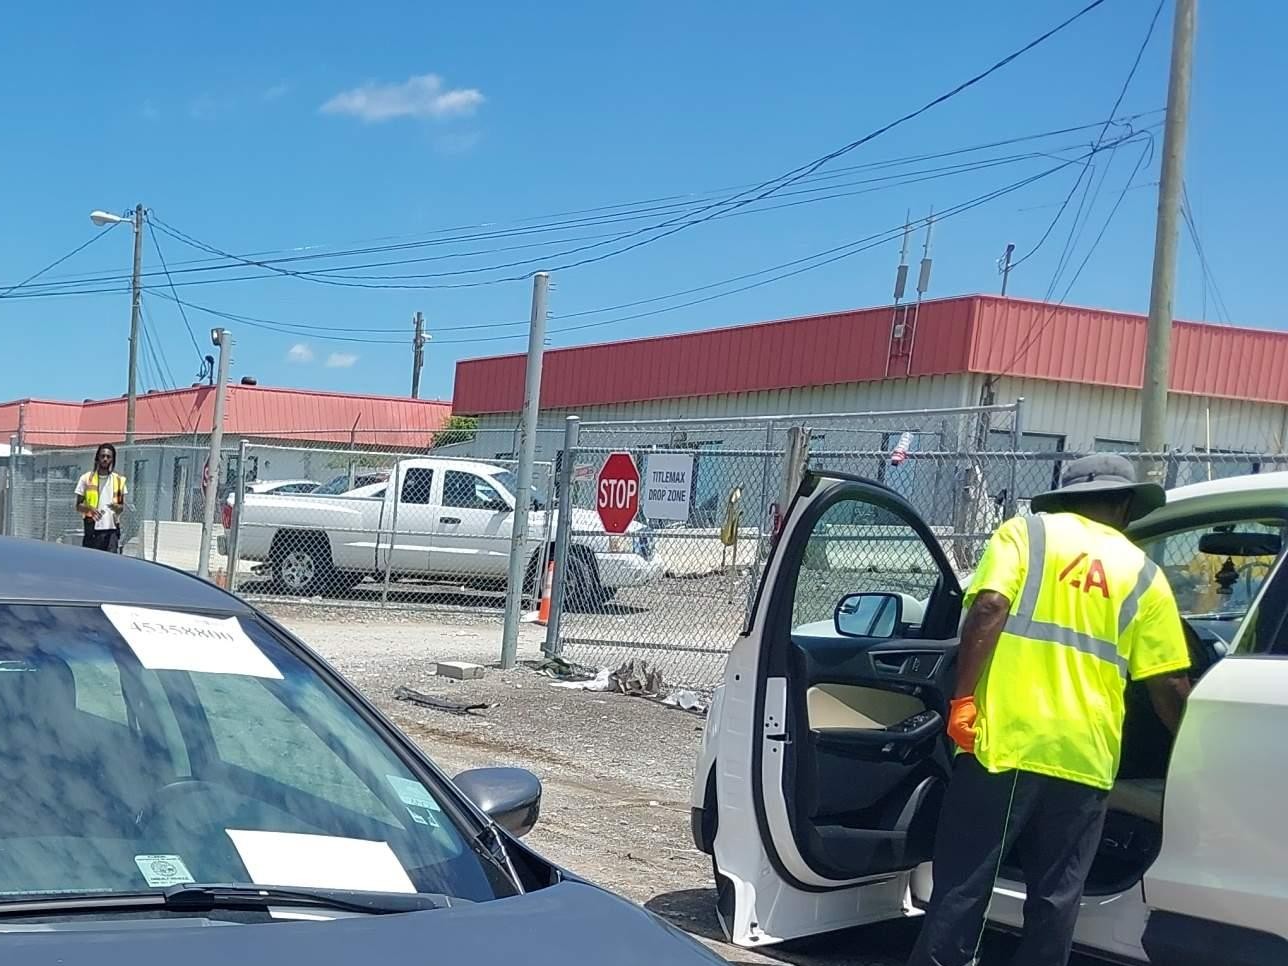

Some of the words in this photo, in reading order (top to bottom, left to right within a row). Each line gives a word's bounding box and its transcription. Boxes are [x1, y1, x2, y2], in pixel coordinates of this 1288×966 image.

[652, 471, 686, 484] TITLEMAX
[599, 478, 637, 509] STOP
[648, 488, 666, 502] DROP
[667, 489, 686, 502] ZONE
